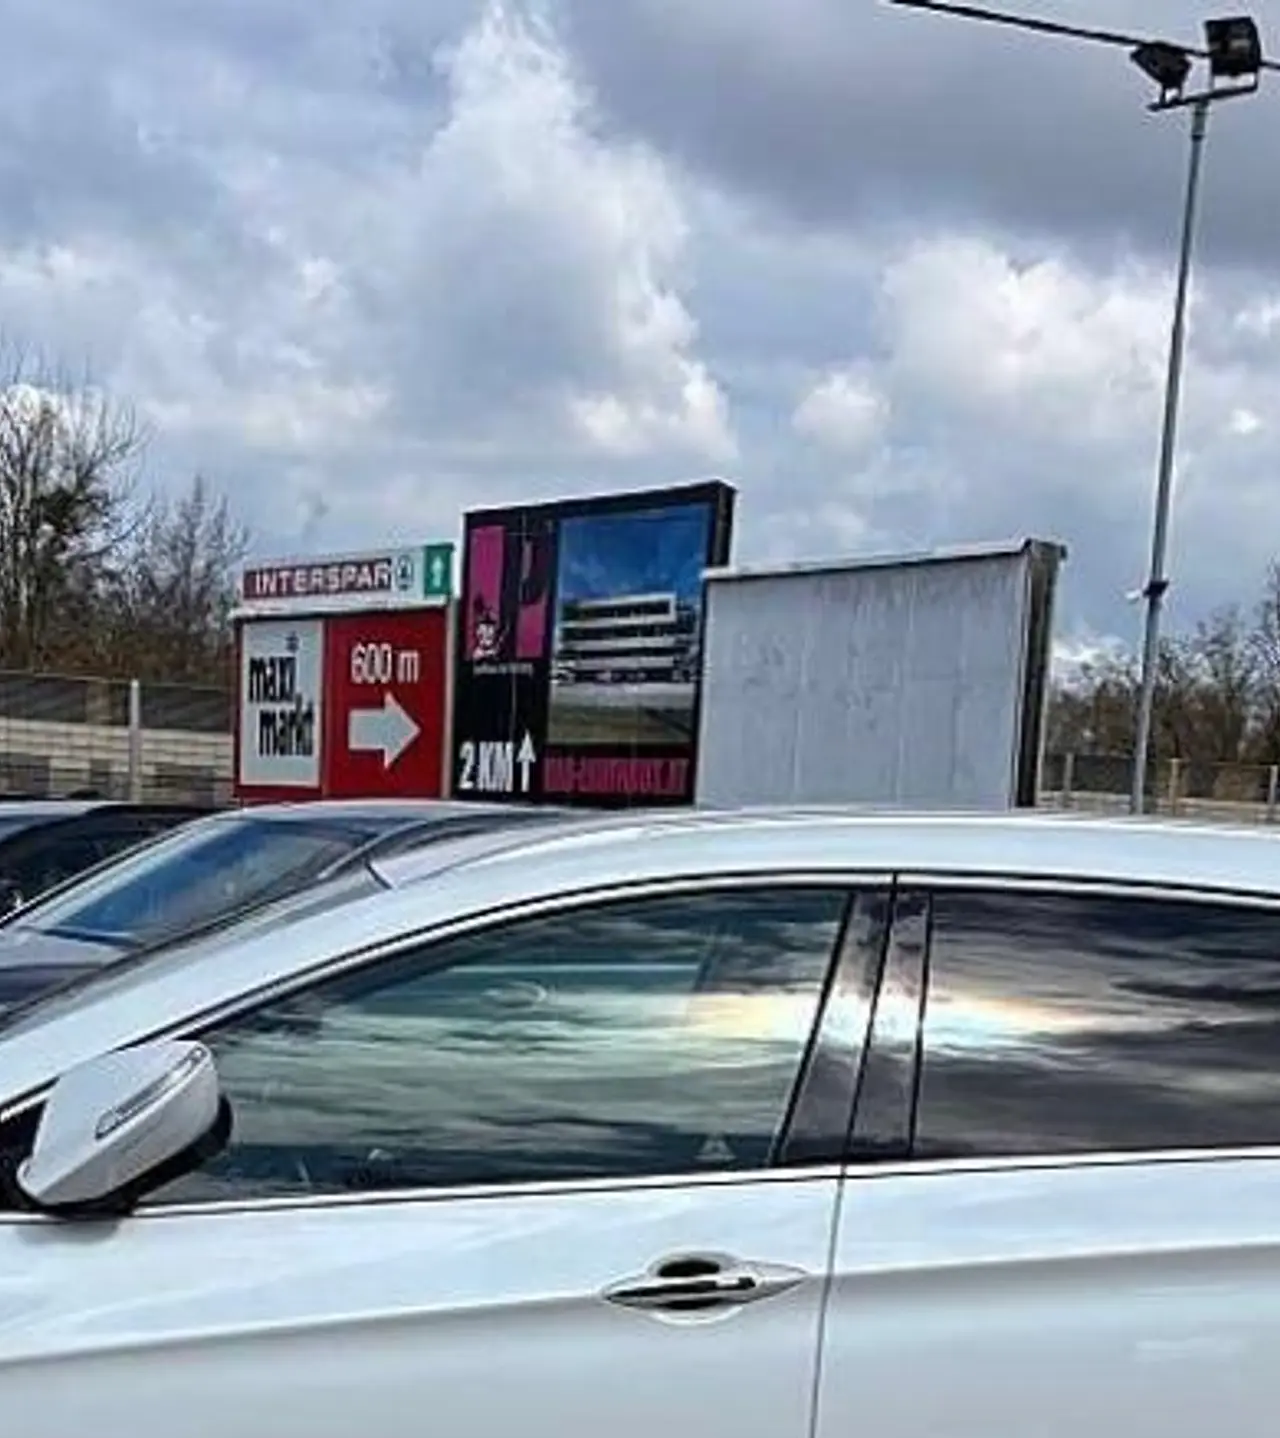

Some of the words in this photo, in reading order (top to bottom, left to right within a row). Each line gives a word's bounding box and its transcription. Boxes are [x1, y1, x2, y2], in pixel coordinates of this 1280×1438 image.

[254, 559, 392, 595] INTERSPAR
[350, 643, 393, 684] 600
[397, 650, 420, 683] m
[258, 693, 315, 757] markt
[458, 741, 474, 790] 2
[477, 741, 514, 792] KM
